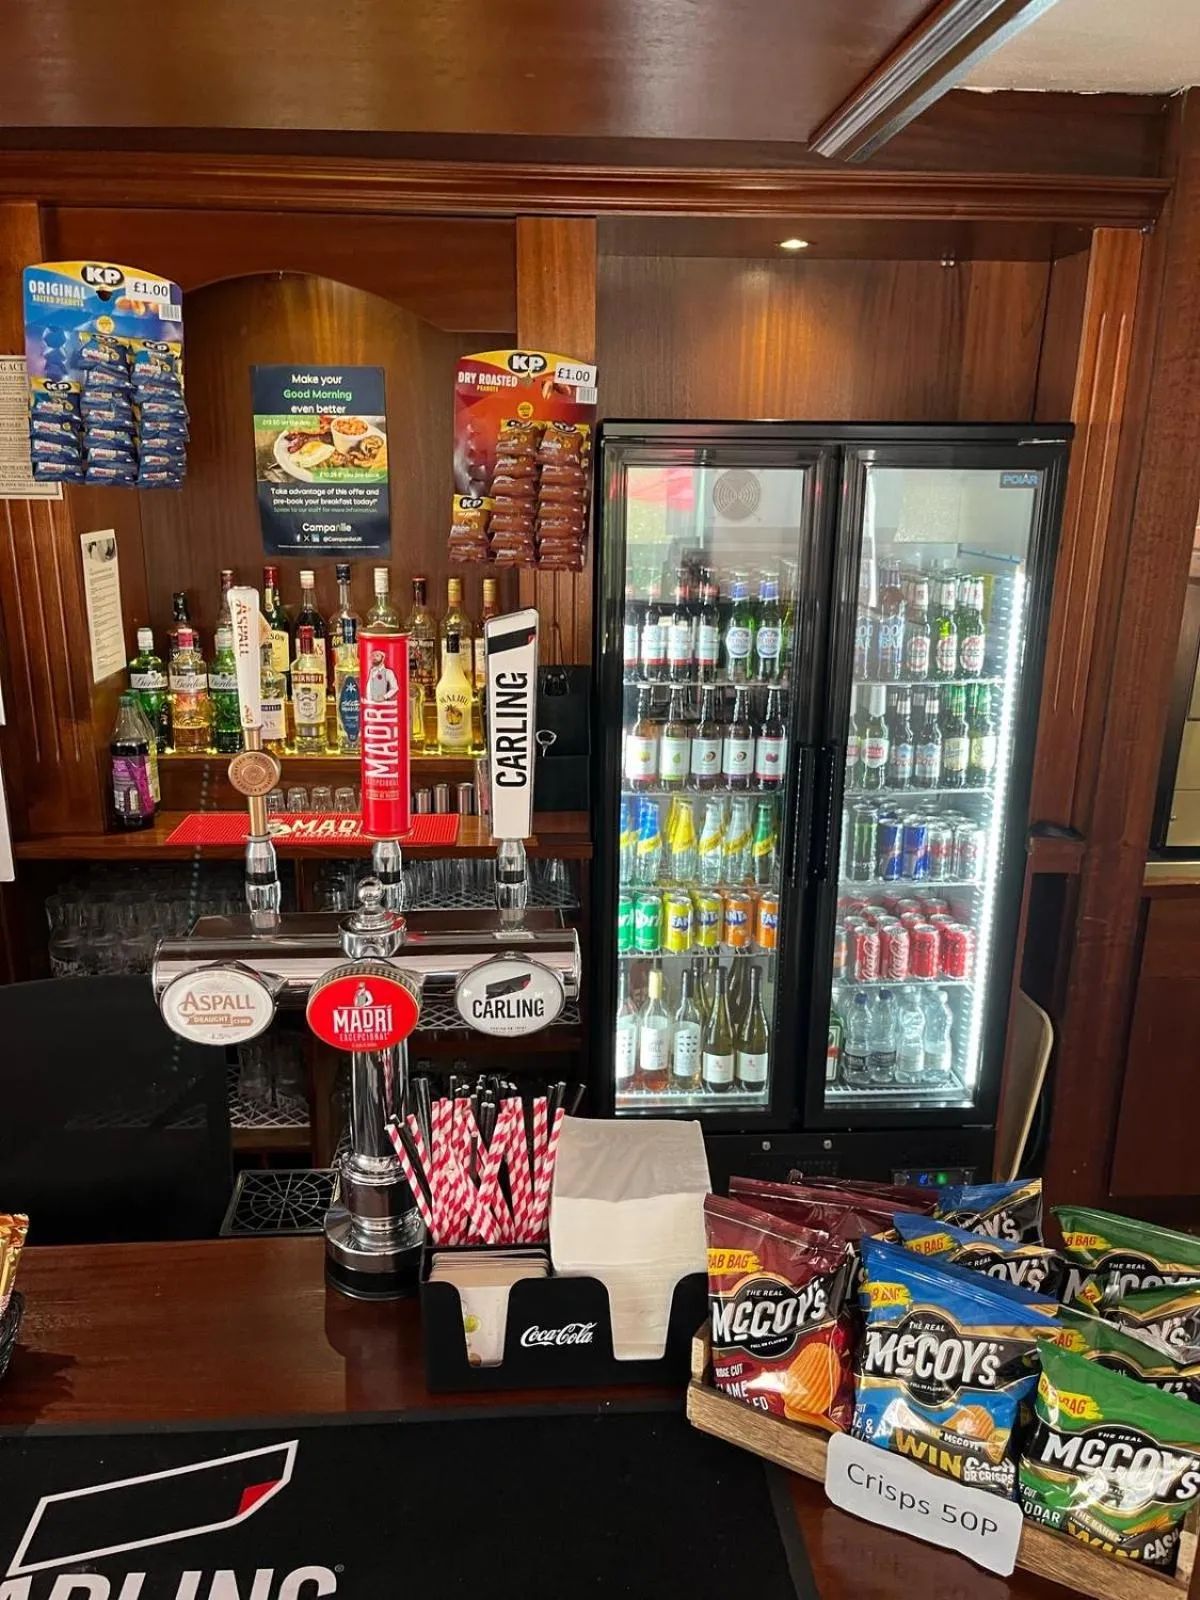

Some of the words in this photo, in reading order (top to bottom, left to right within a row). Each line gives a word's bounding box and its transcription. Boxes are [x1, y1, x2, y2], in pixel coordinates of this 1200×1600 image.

[86, 266, 121, 284] KP
[29, 279, 87, 300] ORIGINAL
[133, 281, 169, 297] £1.00
[512, 355, 545, 370] KP
[292, 374, 319, 384] Make
[320, 375, 343, 386] your
[458, 371, 476, 384] DRY
[479, 373, 518, 388] ROASTED
[557, 367, 590, 382] £1.00
[283, 389, 310, 399] Good
[312, 389, 353, 401] Morning
[291, 405, 314, 414] even
[316, 404, 347, 414] better
[1002, 472, 1039, 485] POLAR
[271, 487, 288, 495] Take
[289, 488, 326, 496] advantage
[273, 498, 304, 506] pre-book
[304, 498, 320, 506] your
[320, 498, 353, 506] breakfast
[302, 522, 352, 534] Campanile
[495, 672, 528, 788] CARLING
[292, 819, 363, 833] MAD
[178, 991, 256, 1014] ASPALL
[472, 998, 544, 1019] CARLING
[193, 1016, 229, 1024] DRAUGHT
[333, 1004, 393, 1034] MADRÍ
[923, 1238, 944, 1254] BAG
[1075, 1235, 1097, 1247] BAG
[727, 1254, 750, 1269] BAG
[746, 1289, 761, 1297] THE
[763, 1289, 783, 1297] REAL
[909, 1321, 922, 1329] THE
[924, 1323, 945, 1332] REAL
[520, 1322, 597, 1347] Coca-Cola
[730, 1363, 743, 1377] CUT
[1098, 1431, 1115, 1439] THE
[1118, 1434, 1143, 1443] REAL
[895, 1430, 962, 1479] WIN
[963, 1470, 978, 1481] OR
[978, 1470, 1015, 1484] CRISPS
[847, 1462, 931, 1515] Crisps
[941, 1503, 998, 1536] 50P
[1024, 1486, 1037, 1498] CUT
